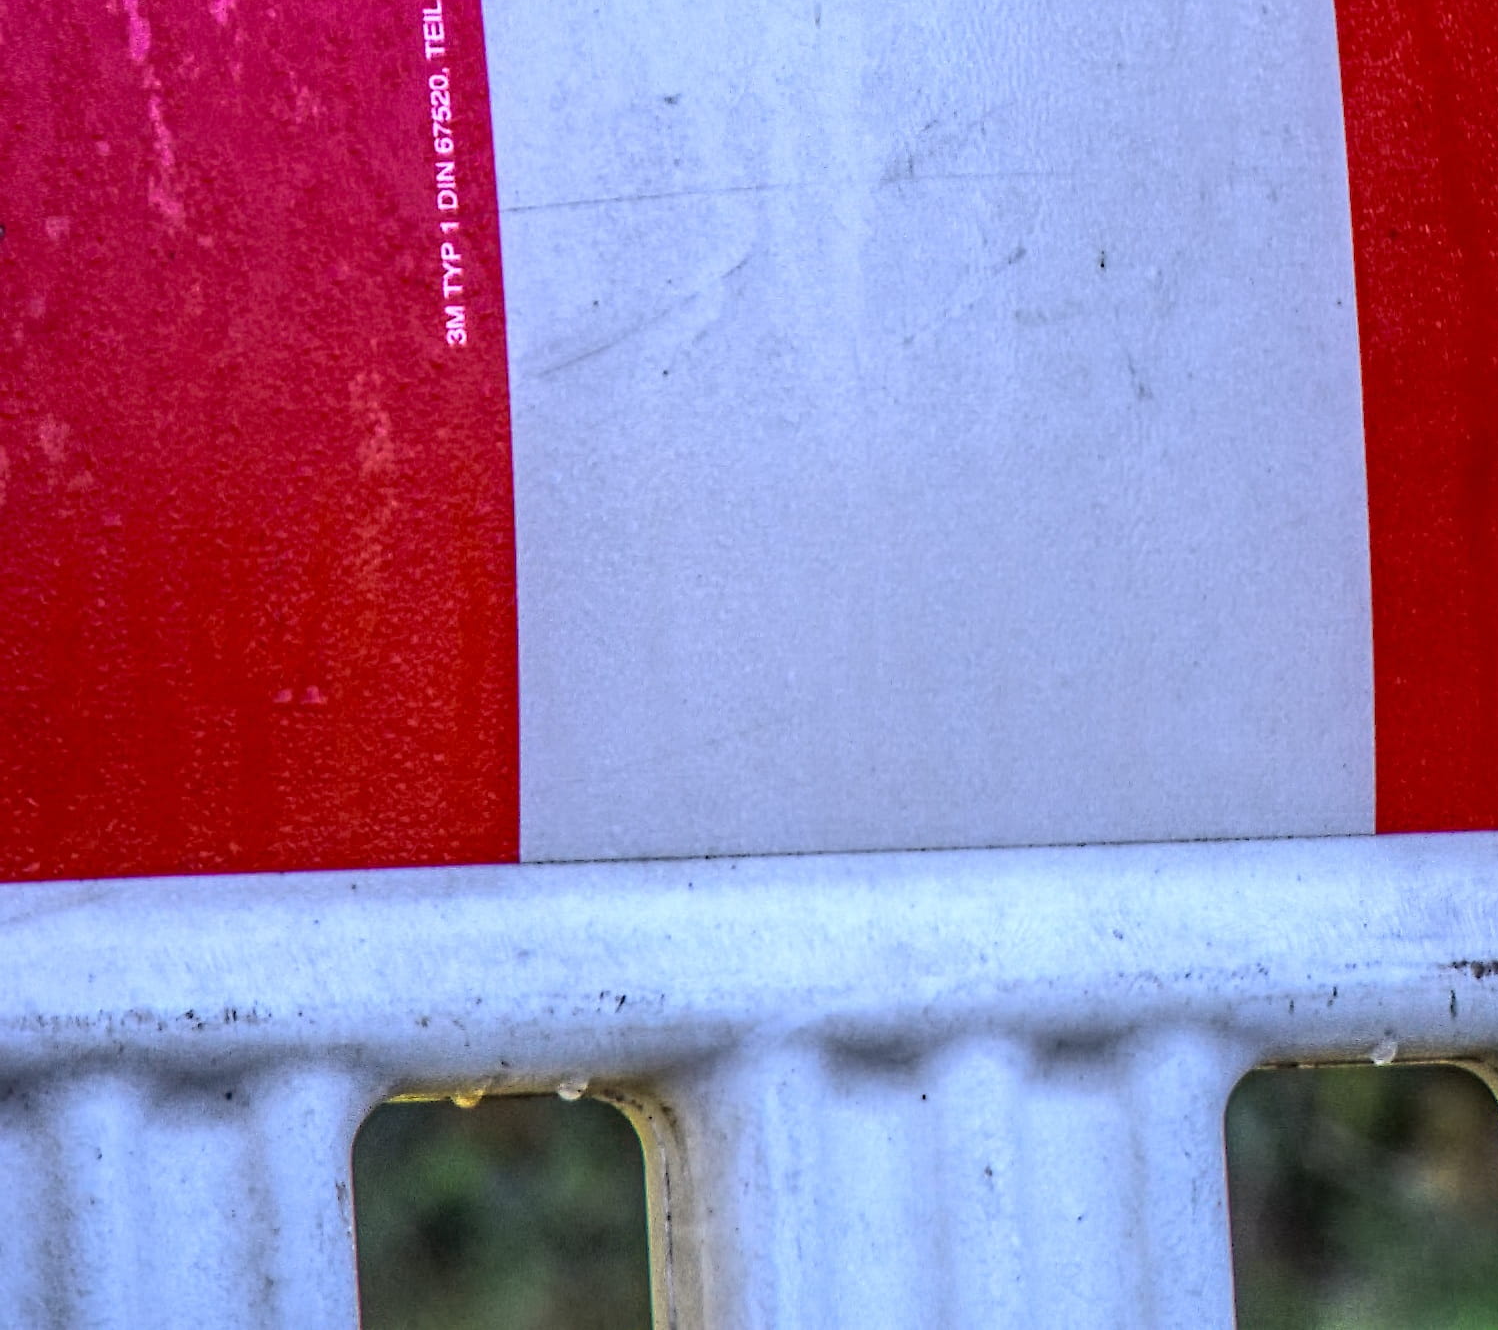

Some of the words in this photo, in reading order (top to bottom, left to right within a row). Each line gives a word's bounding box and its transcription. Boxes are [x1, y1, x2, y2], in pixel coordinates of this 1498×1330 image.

[422, 0, 446, 60] TEIL
[435, 161, 459, 211] DIN
[440, 222, 460, 233] 1
[441, 242, 463, 299] TYP
[445, 306, 467, 345] 3M
